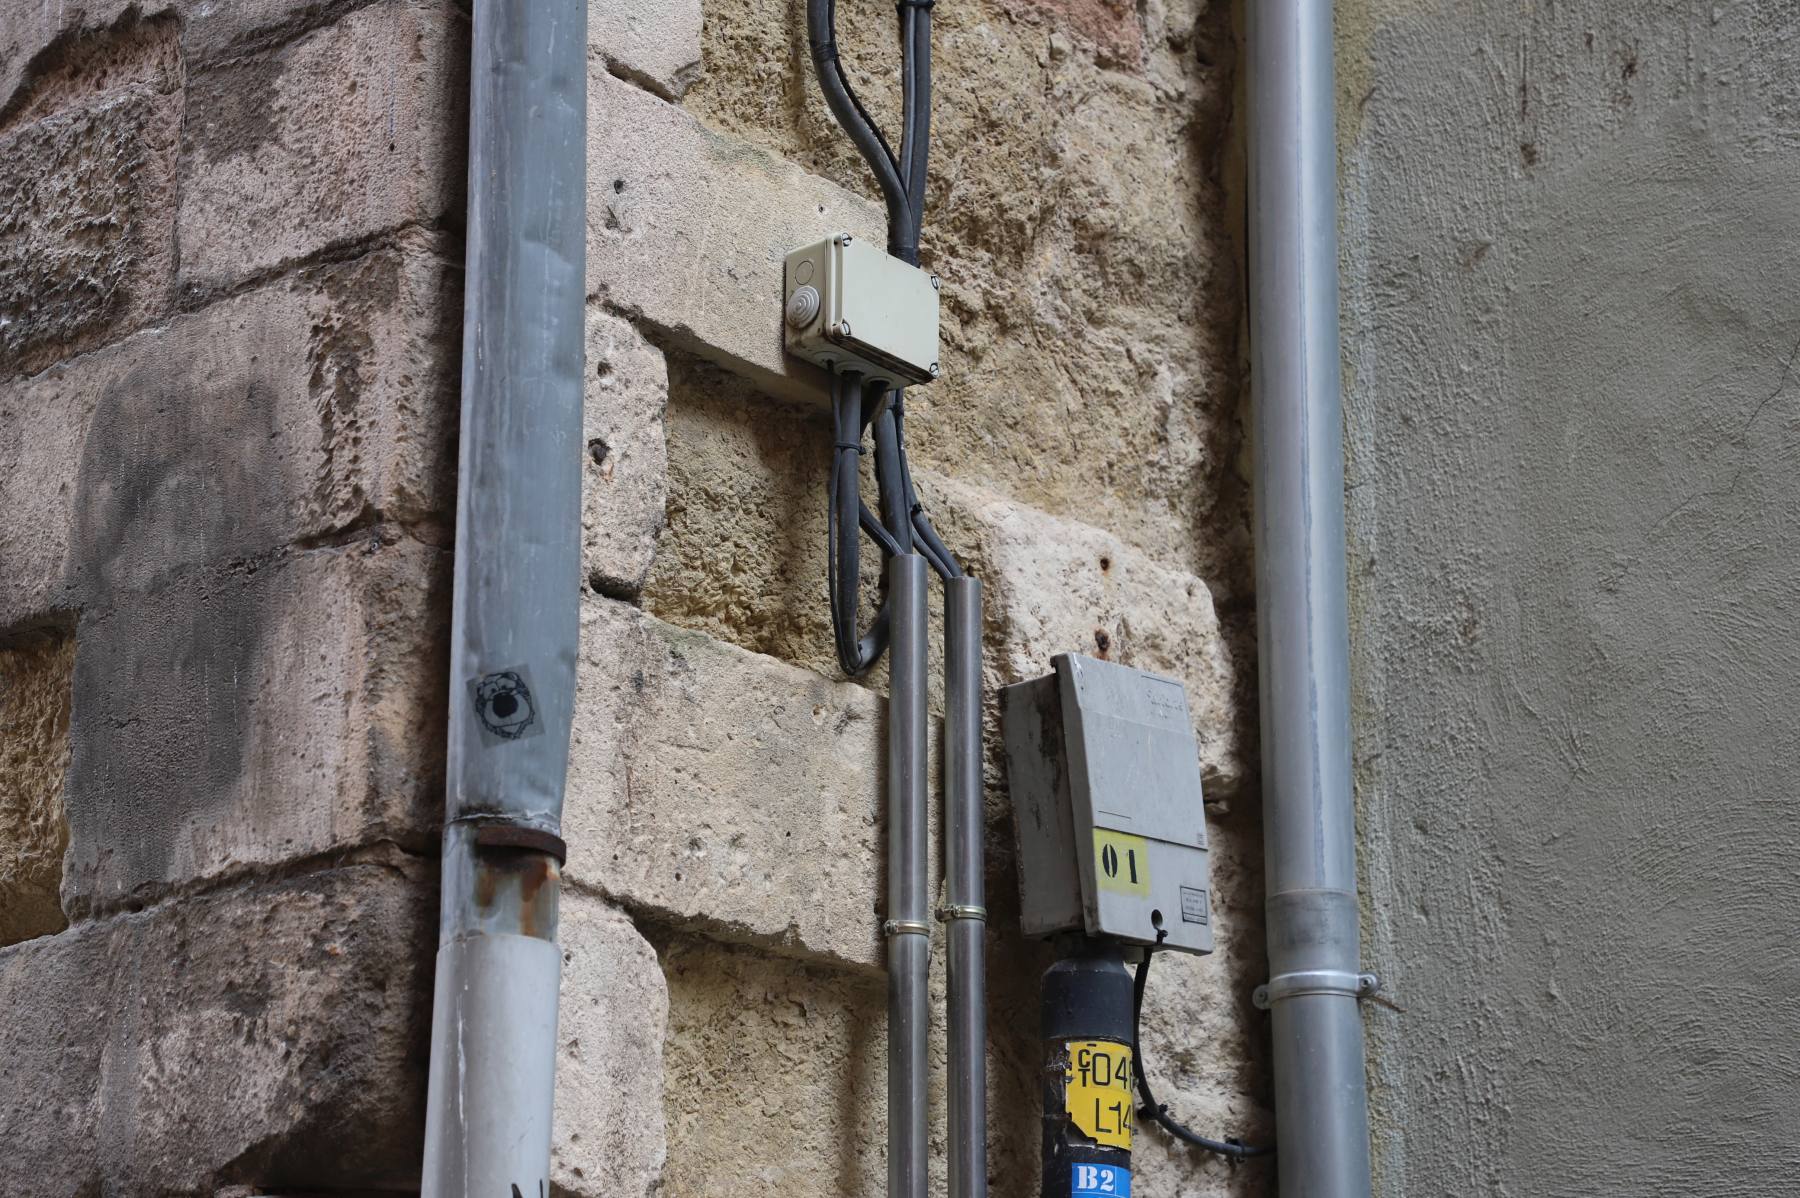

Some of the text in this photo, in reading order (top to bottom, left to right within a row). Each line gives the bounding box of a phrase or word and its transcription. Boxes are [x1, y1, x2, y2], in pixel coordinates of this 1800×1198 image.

[1102, 843, 1138, 884] 01
[1095, 1097, 1132, 1139] L14
[1077, 1165, 1114, 1192] B2
